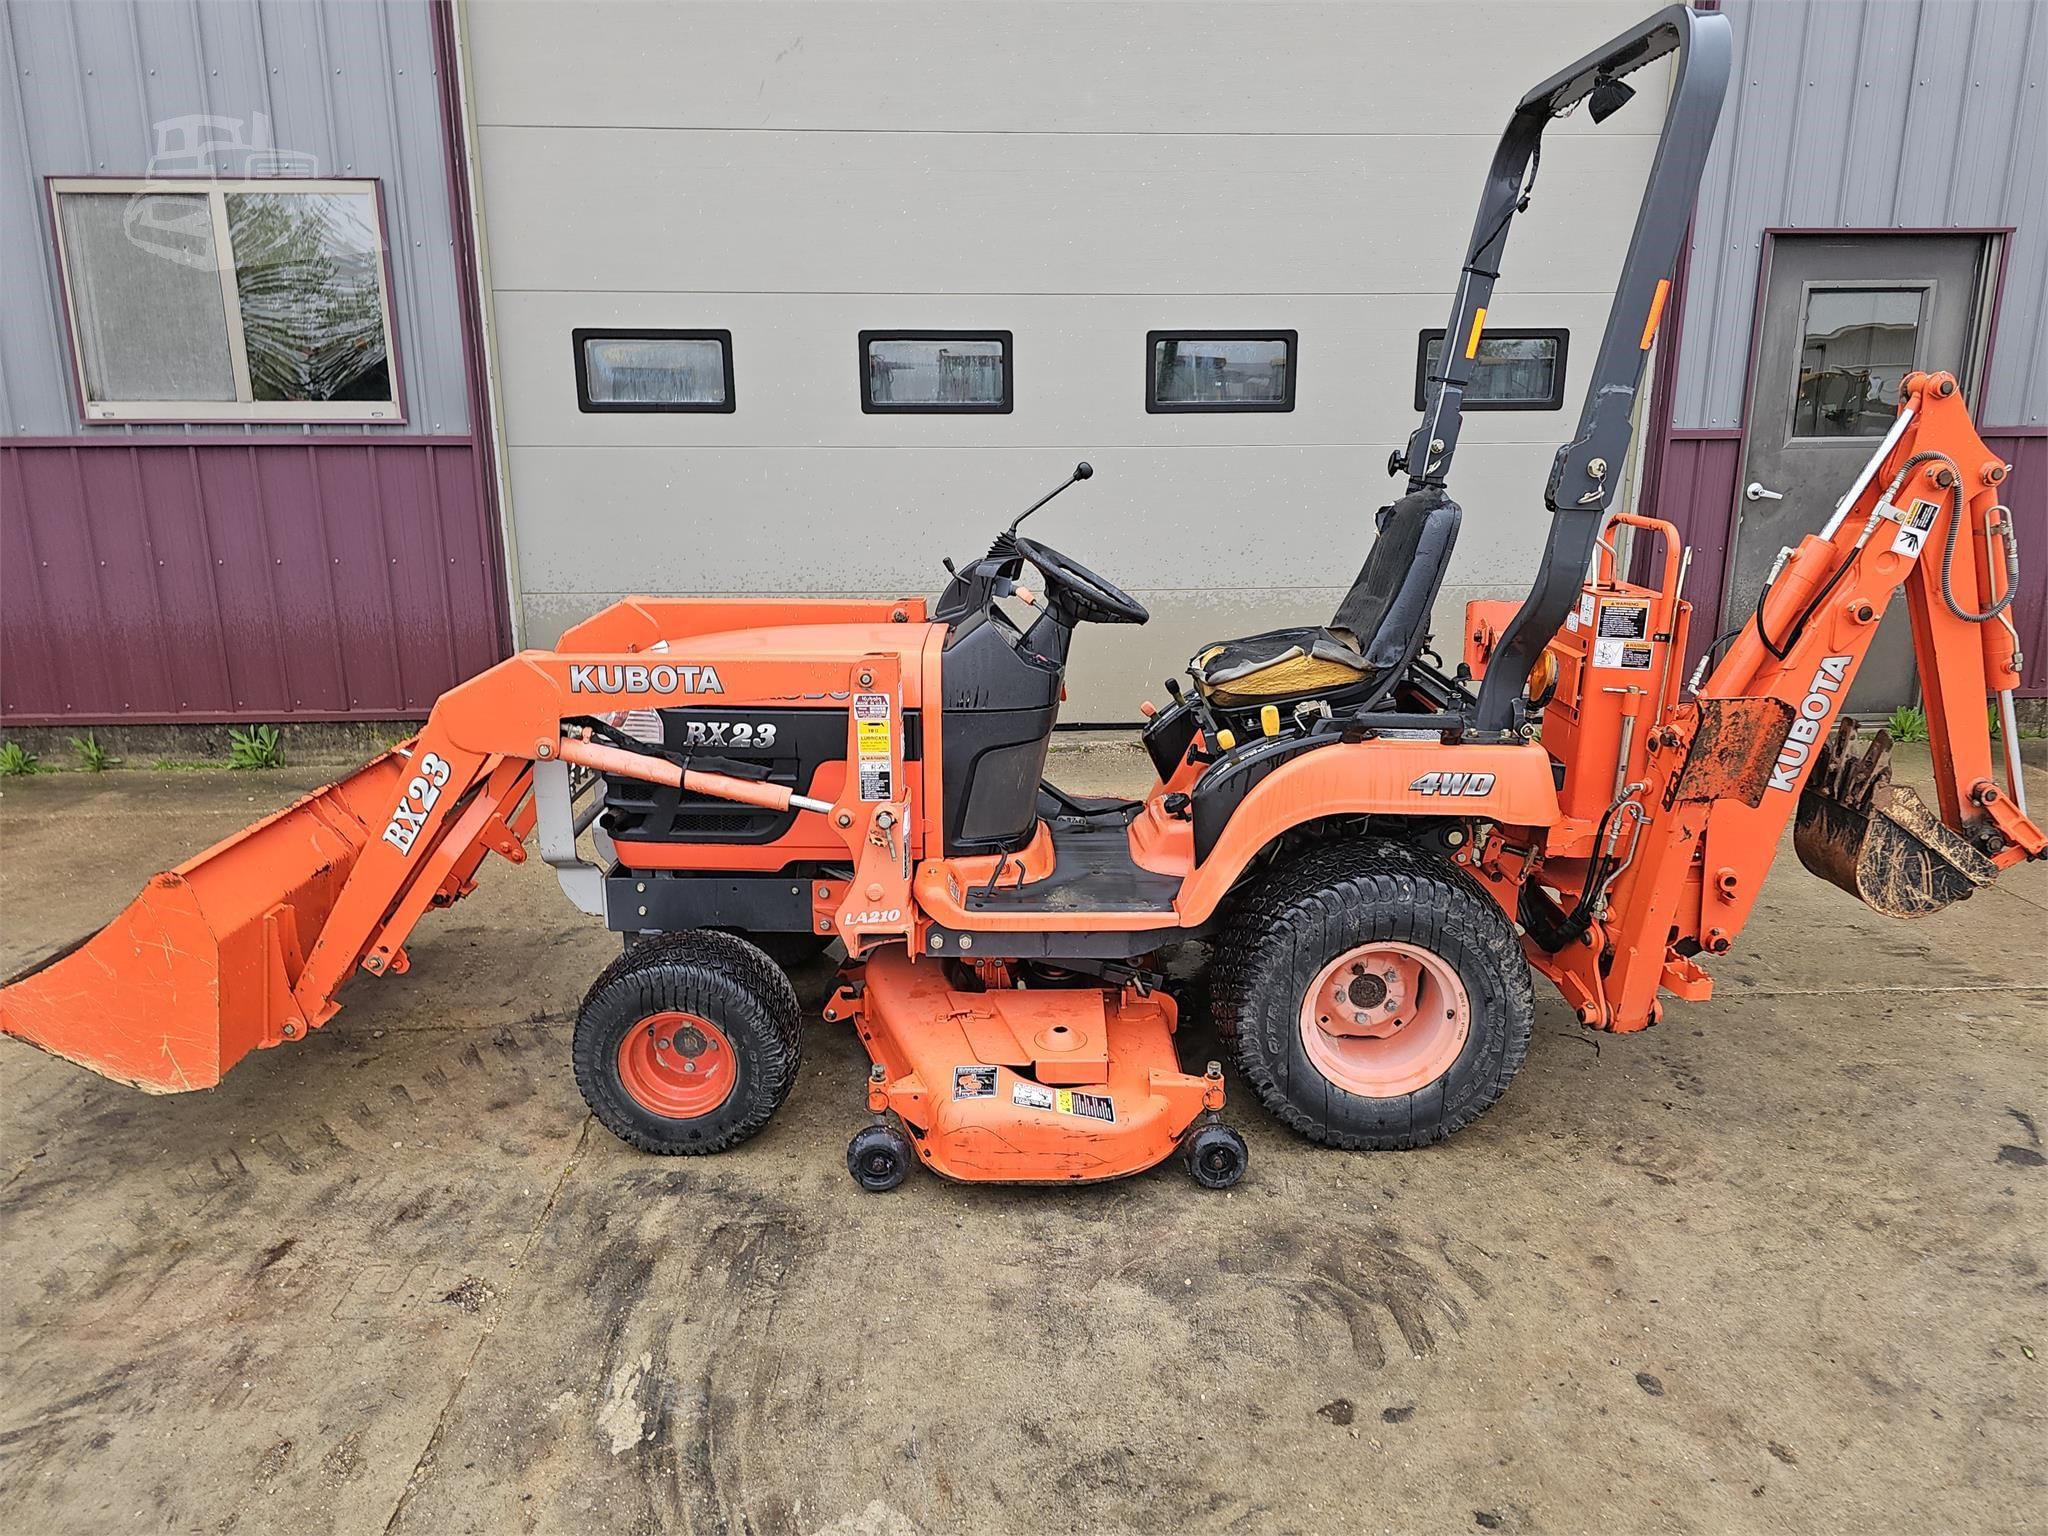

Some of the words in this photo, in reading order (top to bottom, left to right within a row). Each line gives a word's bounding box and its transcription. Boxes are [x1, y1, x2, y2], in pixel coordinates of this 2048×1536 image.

[570, 665, 724, 694] KUBOTA
[683, 721, 777, 749] BX23
[1768, 656, 1854, 792] KUBOTA
[1408, 772, 1496, 797] 4WD
[382, 751, 451, 857] BX23
[844, 908, 901, 926] LA210
